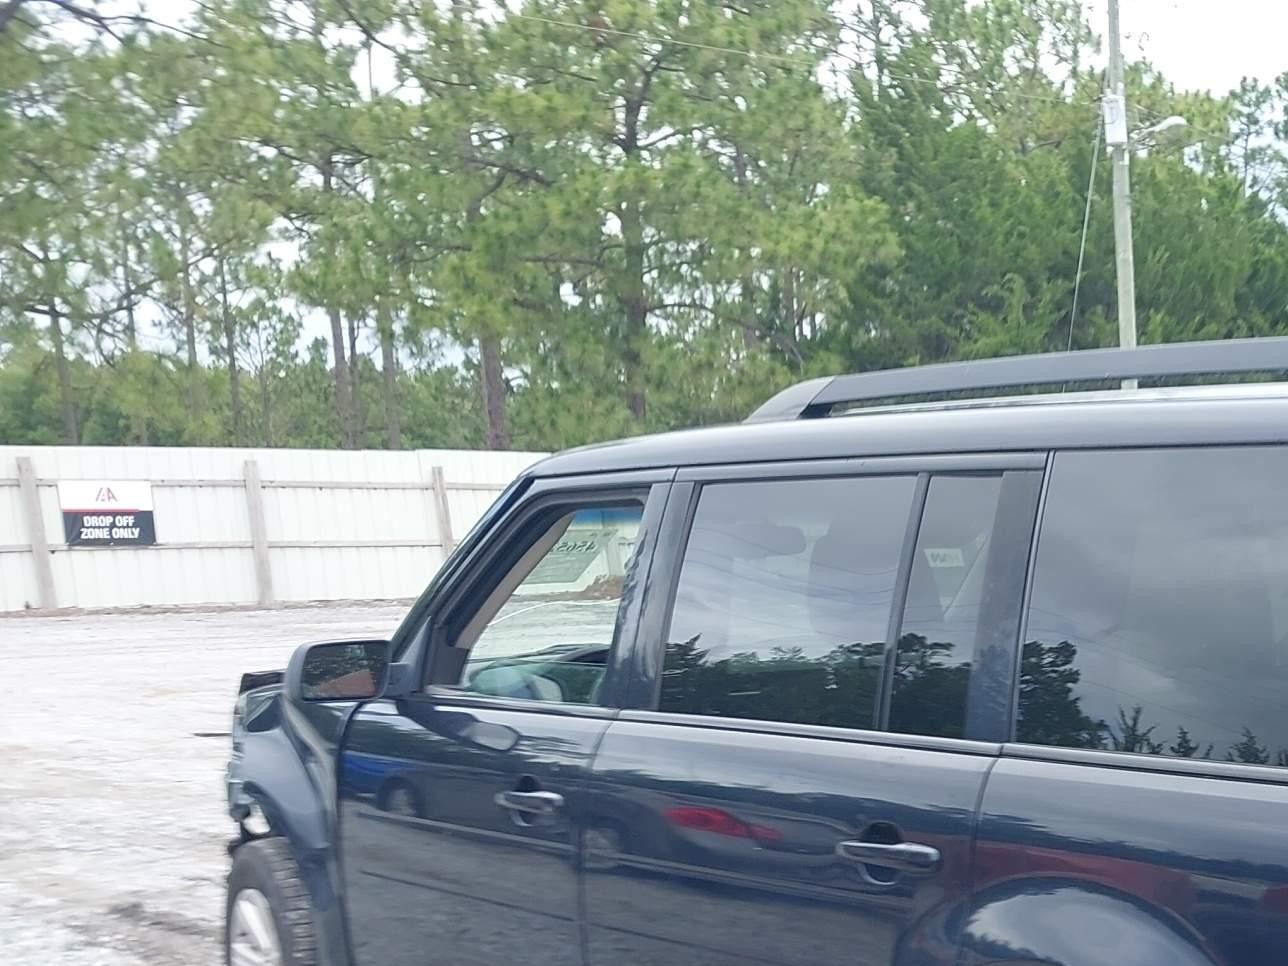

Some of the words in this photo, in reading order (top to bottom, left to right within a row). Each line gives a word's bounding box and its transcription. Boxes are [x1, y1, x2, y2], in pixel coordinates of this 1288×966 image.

[83, 516, 114, 527] DROP
[115, 515, 135, 526] OFF
[80, 528, 111, 539] ZONE
[112, 528, 140, 539] ONLY
